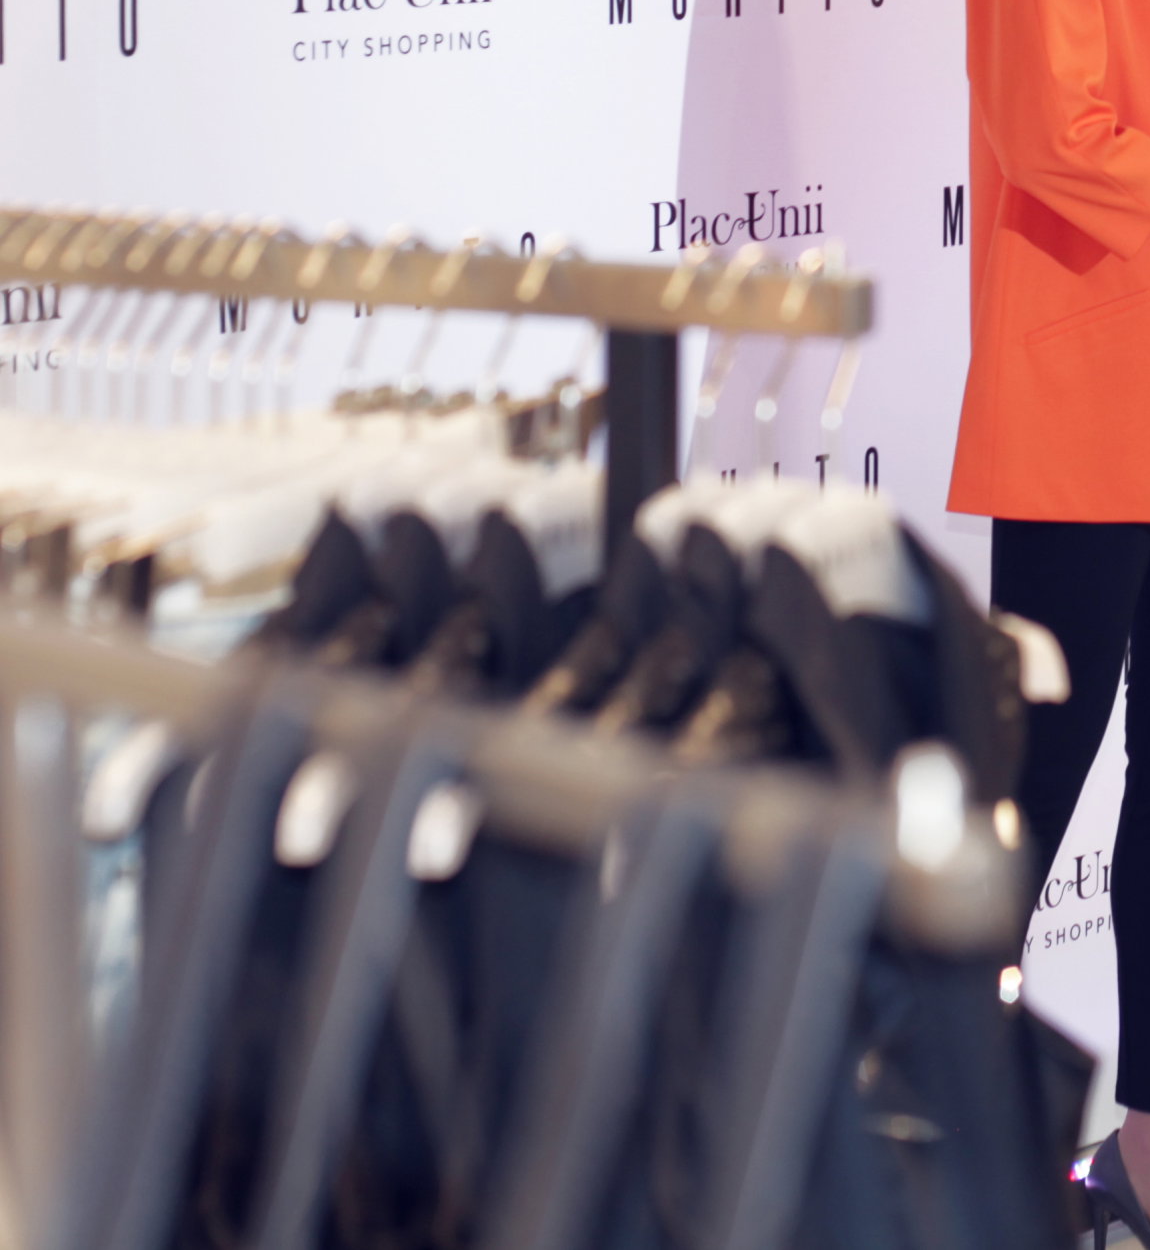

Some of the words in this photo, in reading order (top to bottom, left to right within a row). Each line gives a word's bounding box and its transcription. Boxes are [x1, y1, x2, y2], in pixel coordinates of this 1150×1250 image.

[293, 39, 348, 62] CITY
[364, 30, 490, 57] SHOPPING
[1045, 914, 1111, 949] SHOPPI
